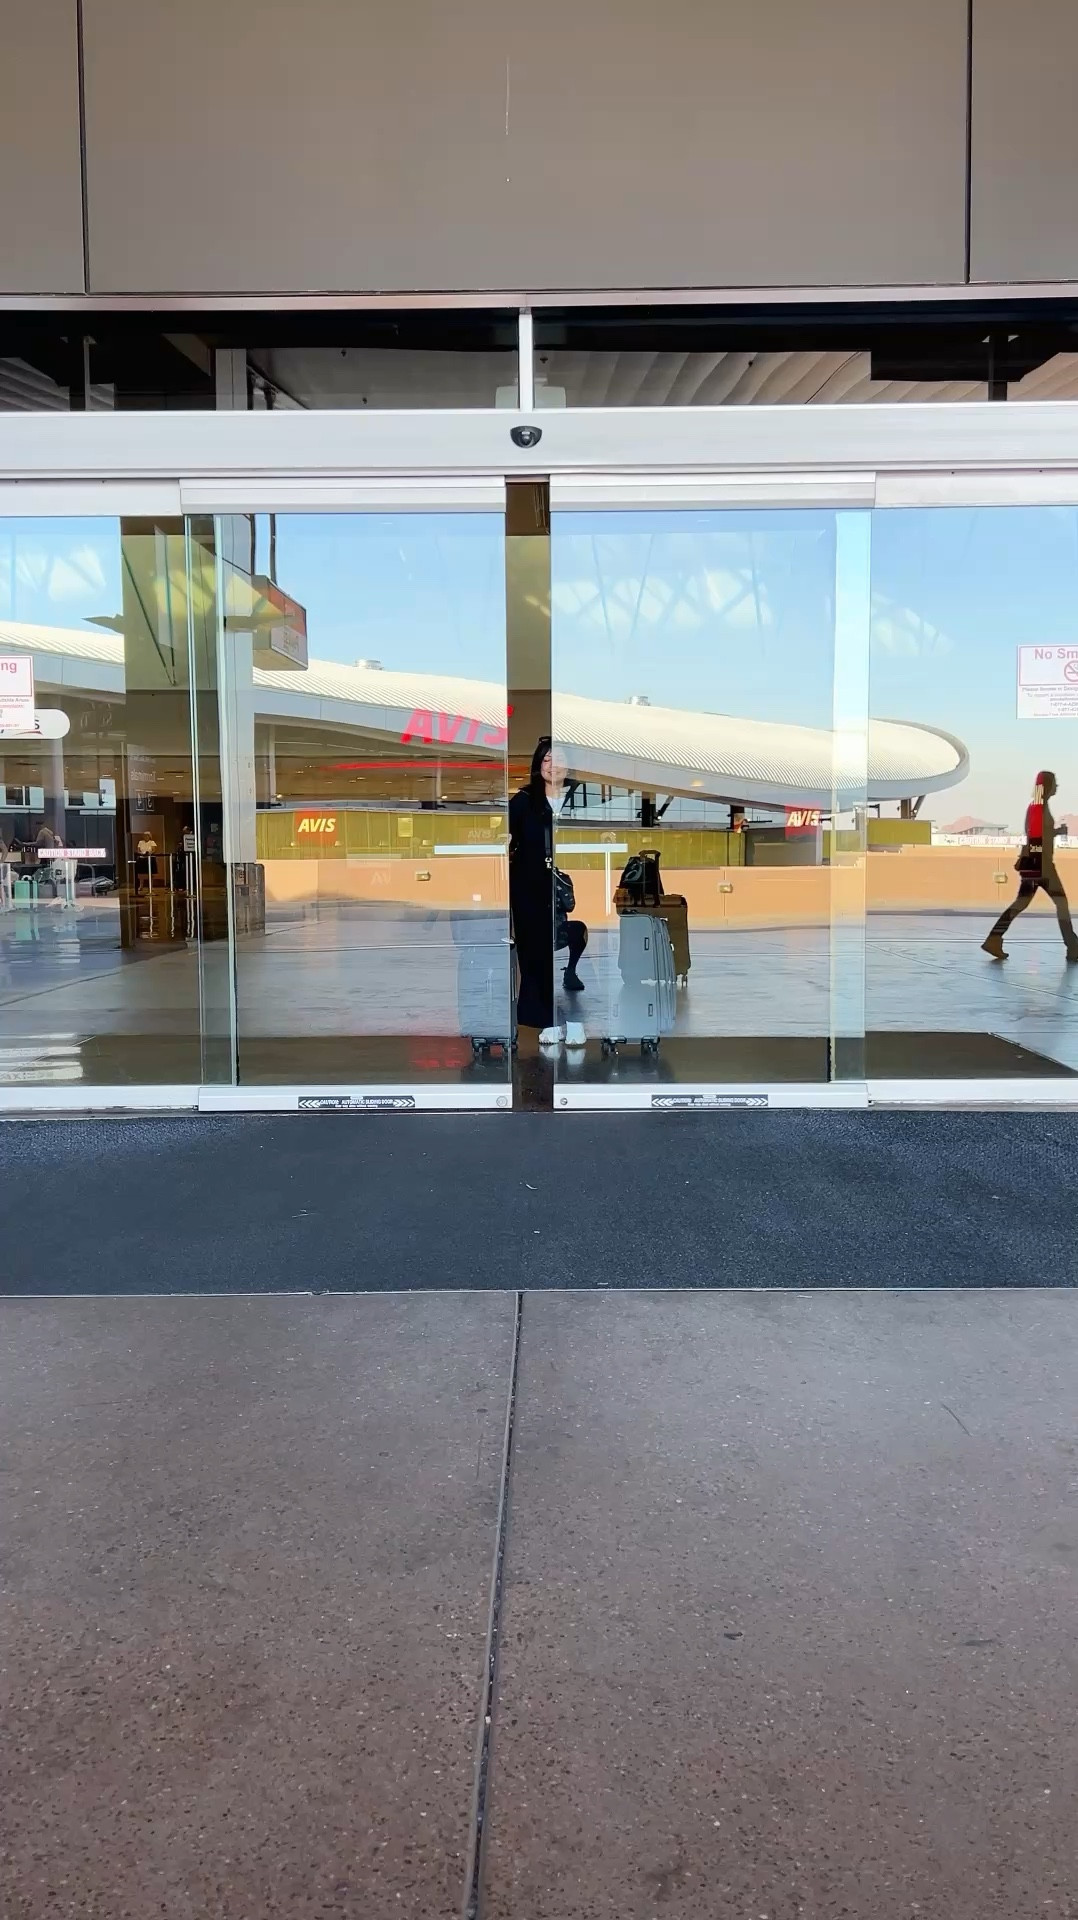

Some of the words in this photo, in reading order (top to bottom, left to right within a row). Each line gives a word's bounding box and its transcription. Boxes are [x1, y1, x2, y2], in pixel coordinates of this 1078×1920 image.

[1034, 648, 1053, 660] No
[401, 704, 514, 745] AVIS
[298, 818, 337, 833] AVIS
[787, 810, 821, 827] AVIS
